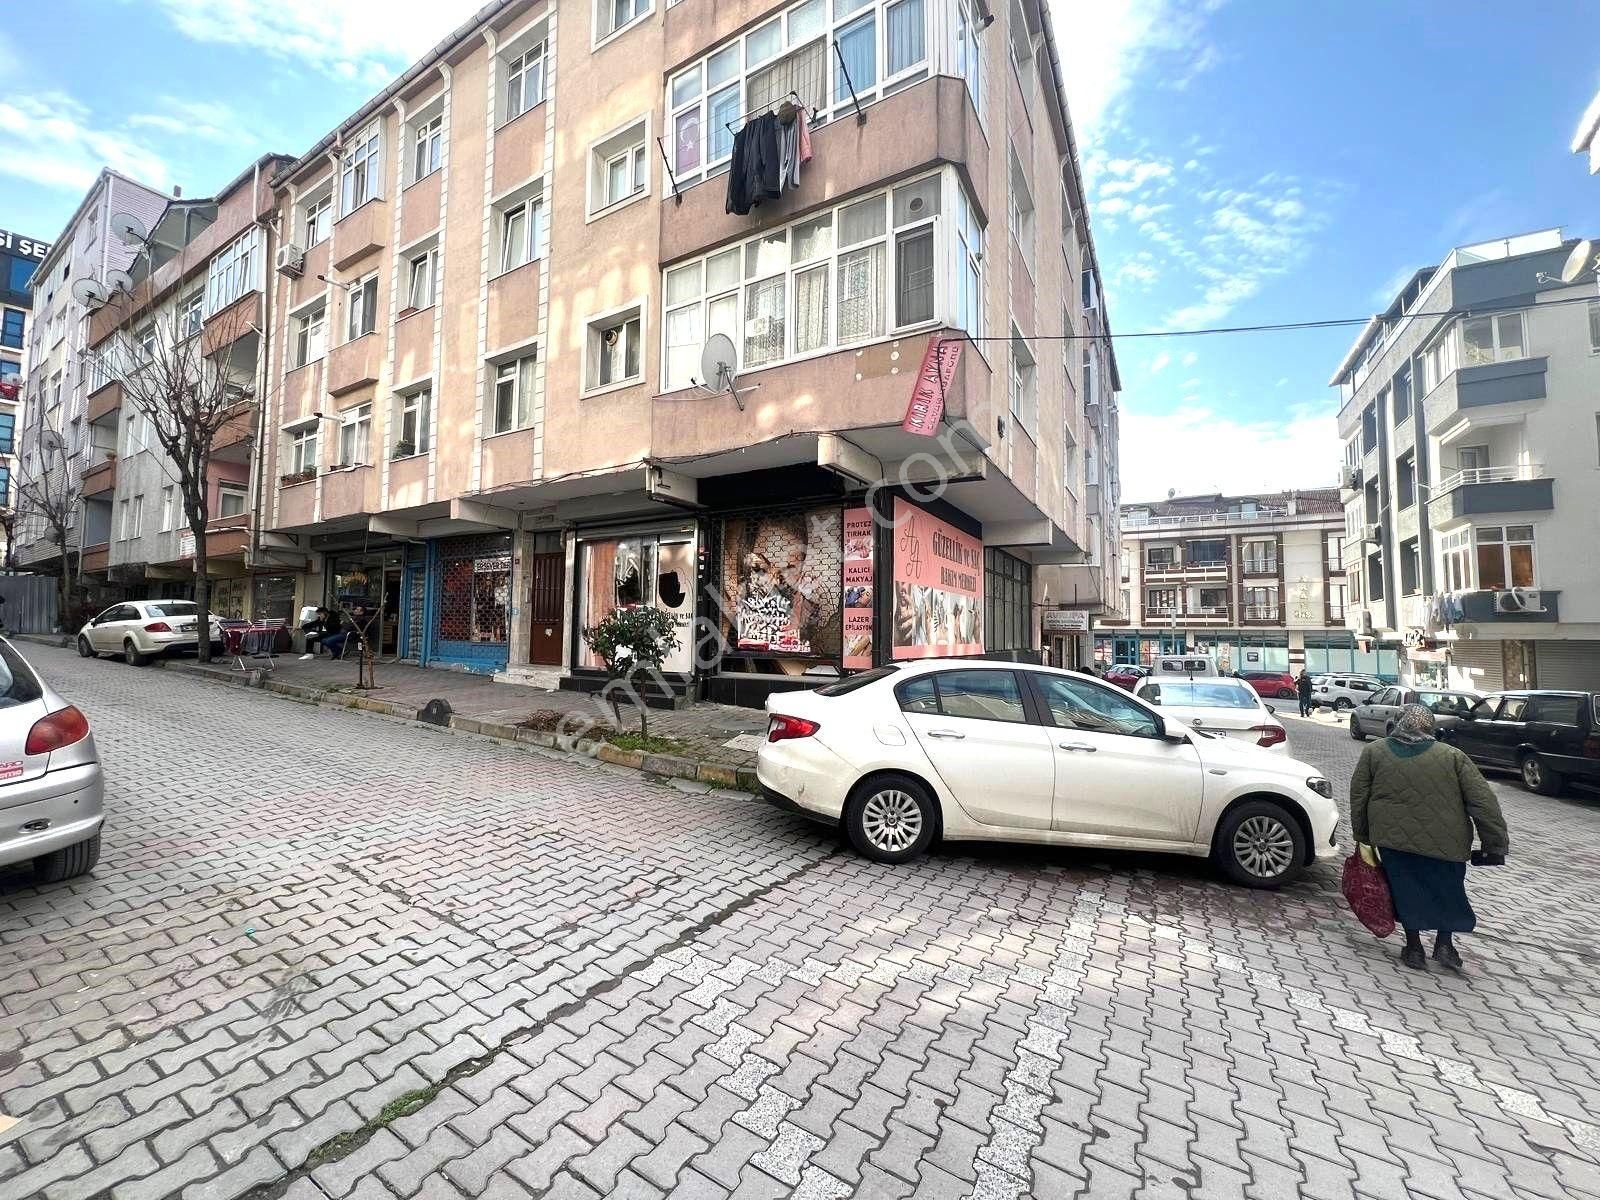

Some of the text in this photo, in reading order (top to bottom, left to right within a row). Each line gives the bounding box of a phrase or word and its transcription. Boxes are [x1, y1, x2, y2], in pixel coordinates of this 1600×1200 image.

[846, 521, 872, 529] PROTEZ
[846, 530, 872, 538] TIRNAK
[933, 528, 962, 565] GÜZELLİK
[845, 574, 872, 582] MAKYAJ
